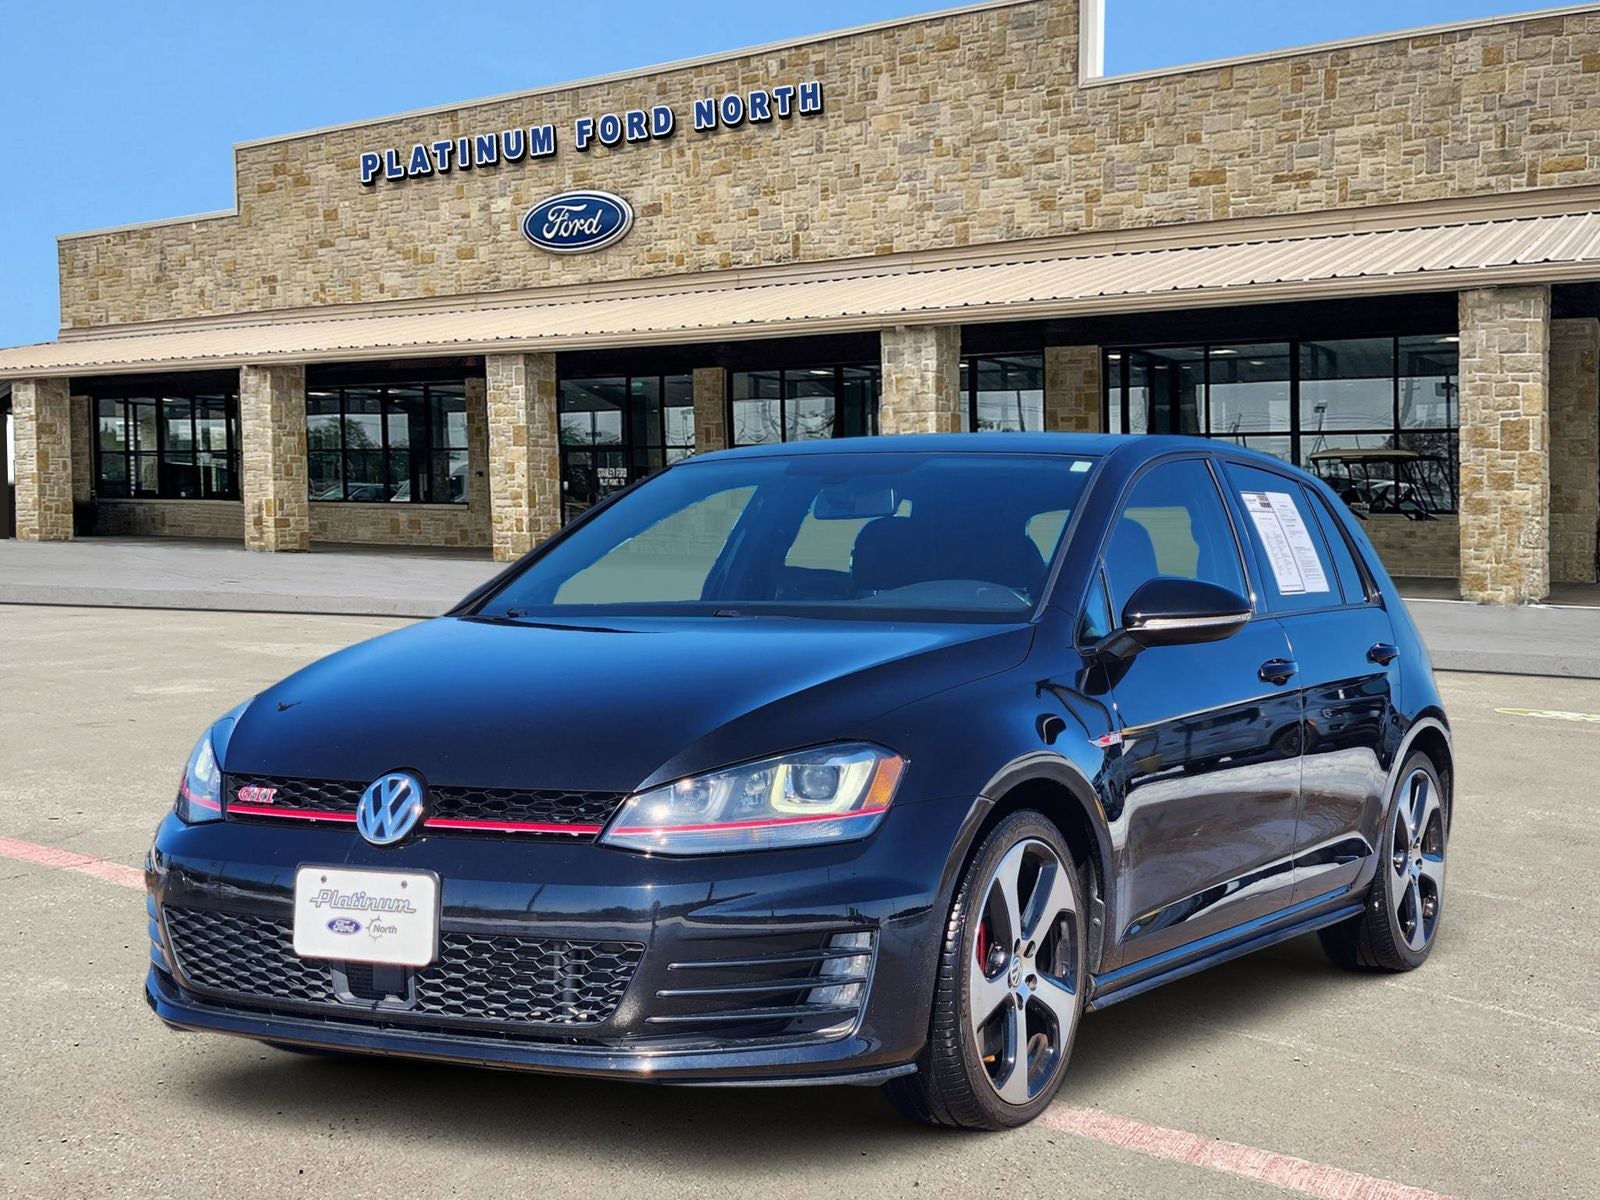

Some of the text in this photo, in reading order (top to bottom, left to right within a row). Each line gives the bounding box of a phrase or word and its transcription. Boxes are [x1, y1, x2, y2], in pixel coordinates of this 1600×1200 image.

[360, 81, 824, 186] PLATINUM FORD NORTH
[541, 204, 602, 239] Ford
[309, 888, 417, 914] Platinum
[373, 924, 397, 934] North
